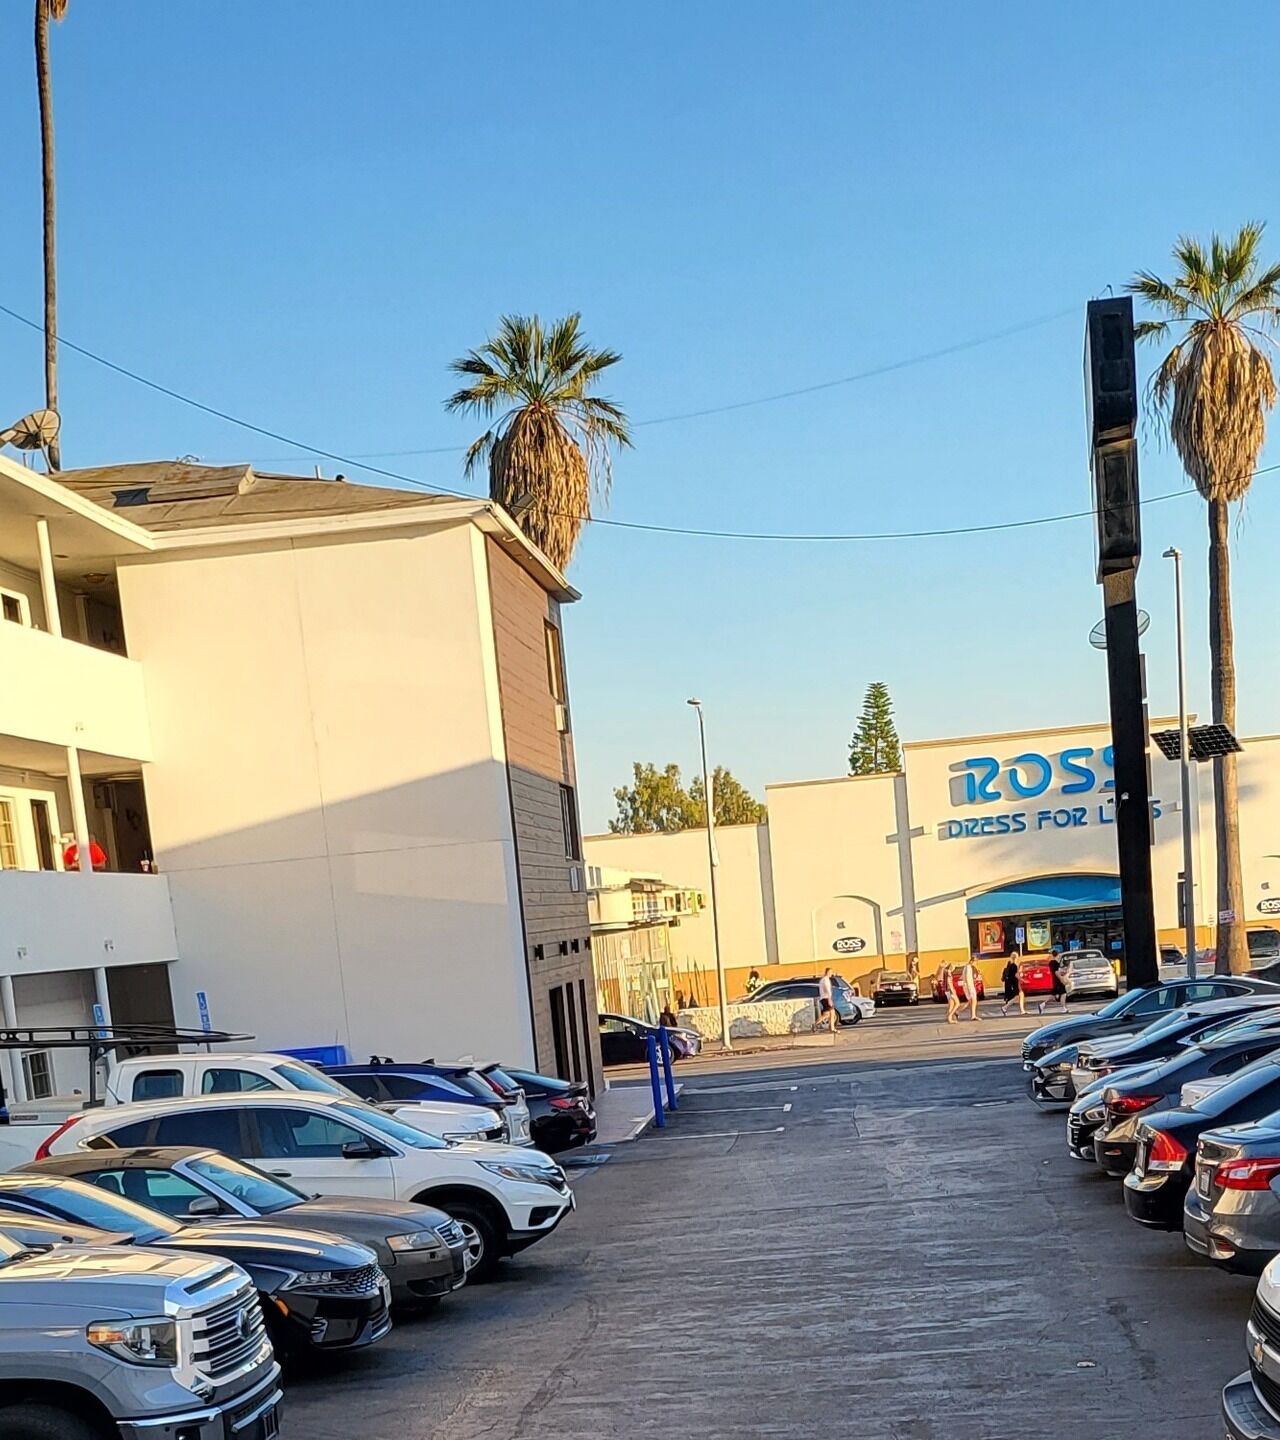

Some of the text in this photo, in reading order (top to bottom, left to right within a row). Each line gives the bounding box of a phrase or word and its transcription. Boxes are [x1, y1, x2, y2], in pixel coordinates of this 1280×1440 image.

[947, 812, 1027, 839] DRESS
[1037, 807, 1088, 830] FOR
[836, 938, 862, 949] ROSS
